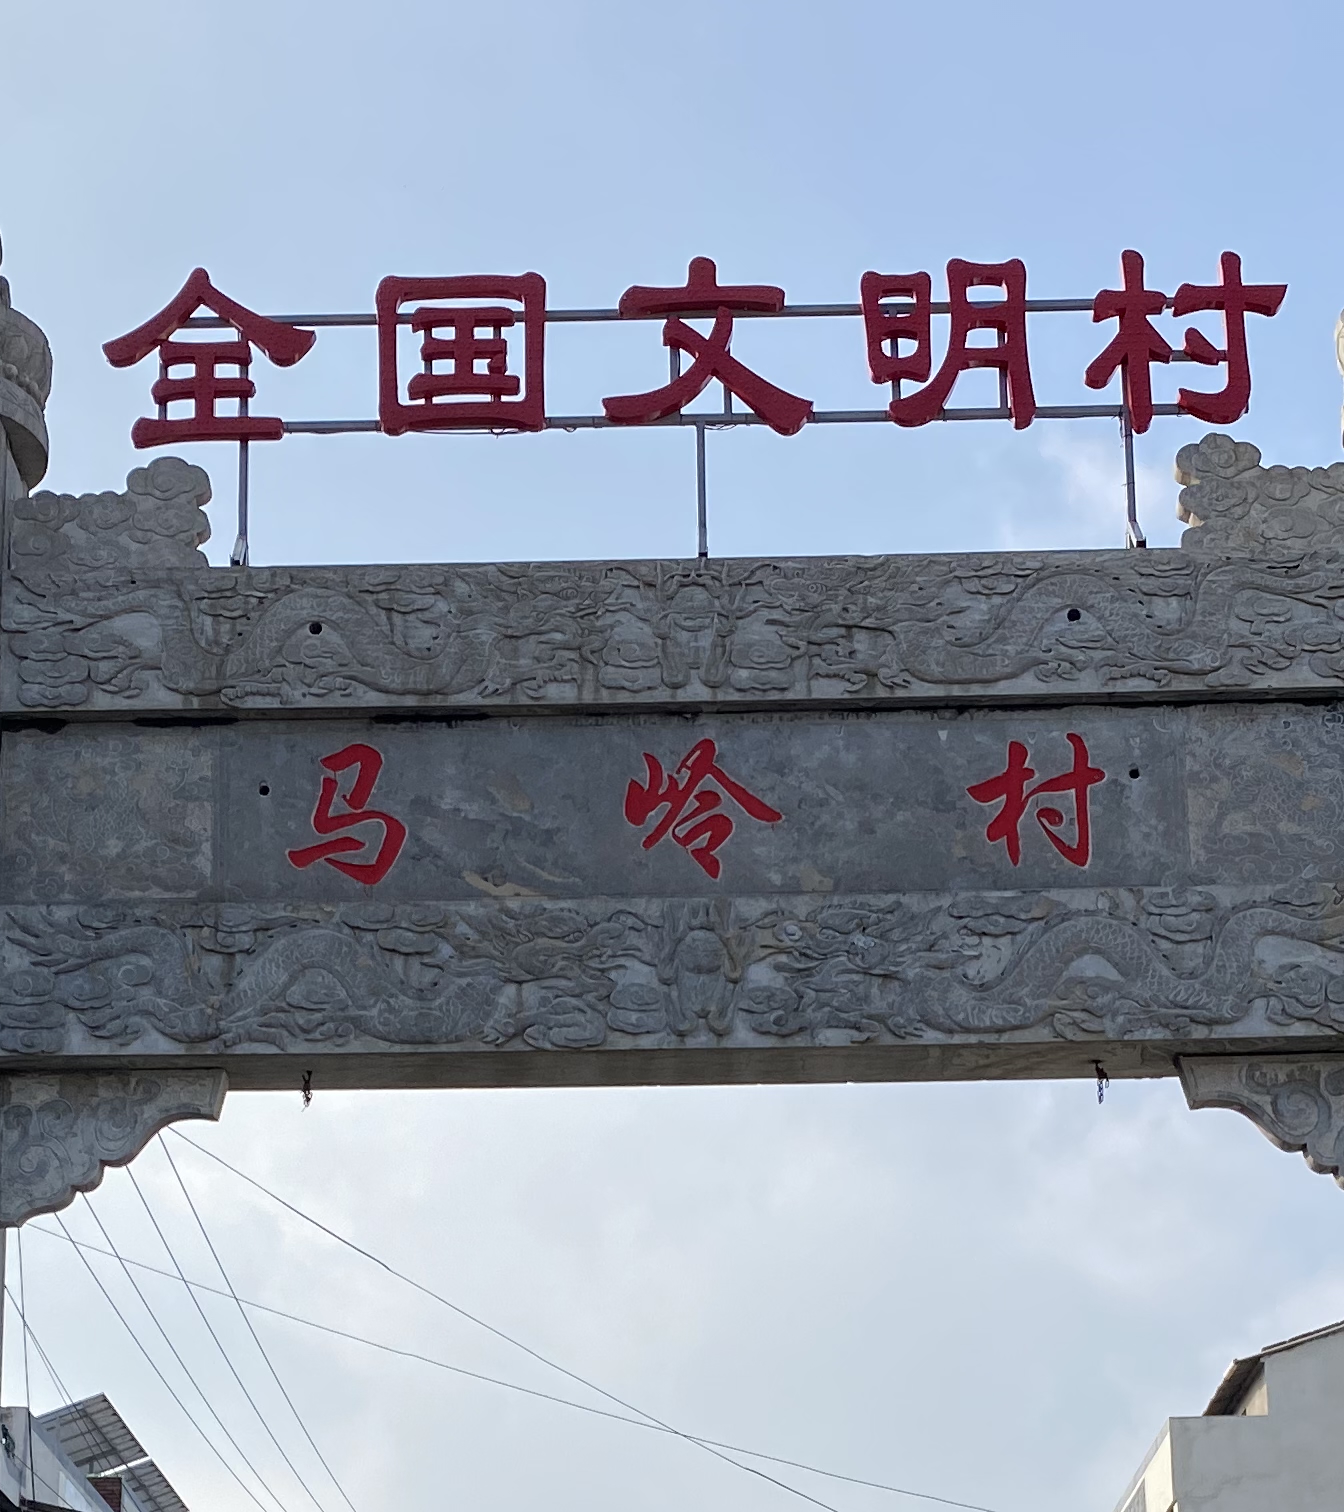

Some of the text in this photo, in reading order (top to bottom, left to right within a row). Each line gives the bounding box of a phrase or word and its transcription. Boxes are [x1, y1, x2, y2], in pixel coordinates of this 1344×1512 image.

[103, 250, 1287, 447] 全国文明村
[287, 732, 1105, 886] 马岭村
